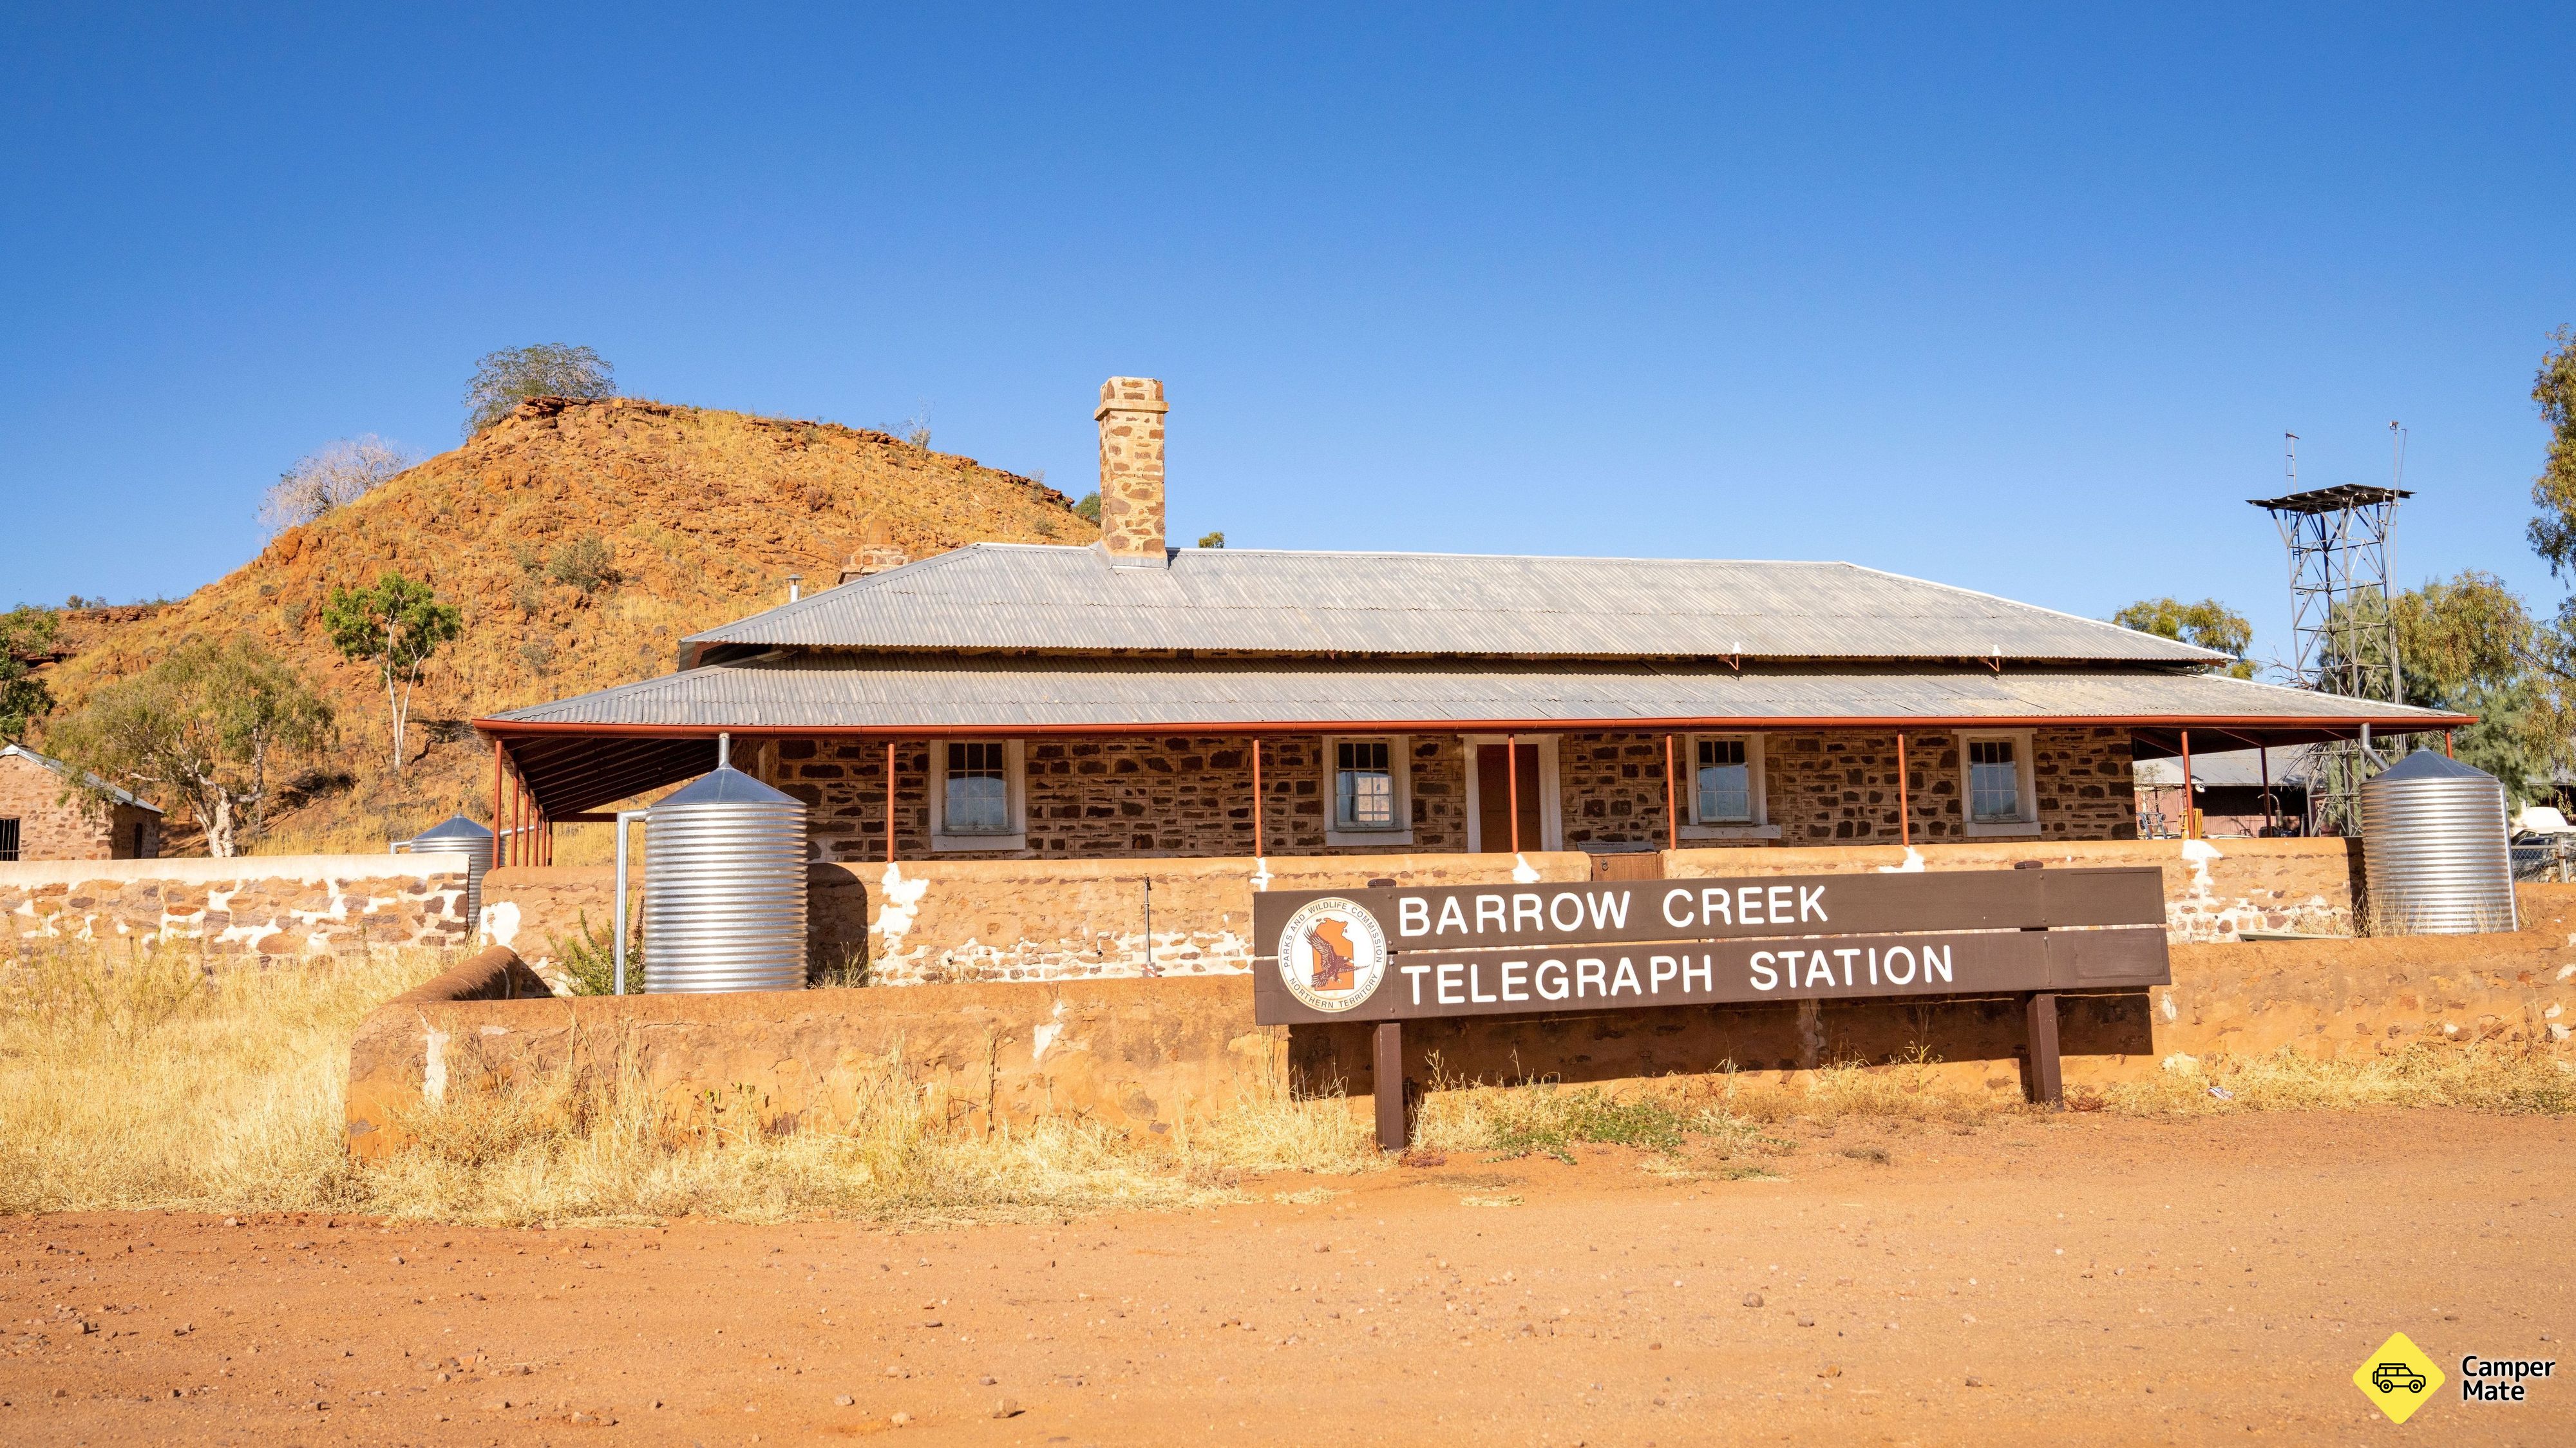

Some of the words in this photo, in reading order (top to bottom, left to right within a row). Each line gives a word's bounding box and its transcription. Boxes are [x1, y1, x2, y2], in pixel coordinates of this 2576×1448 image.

[1283, 934, 1293, 967] PARKS
[1291, 913, 1305, 932] AND
[1307, 901, 1347, 914] WILDLIFE
[1351, 907, 1383, 963] COMMISSION
[1399, 890, 1631, 937] BARROW
[1662, 885, 1829, 928] CREEK
[1289, 977, 1334, 1009] NORTHERN
[1338, 973, 1378, 1008] TERRITORY
[1400, 955, 1712, 1005] TELEGRAPH
[1750, 944, 1953, 991] STATION
